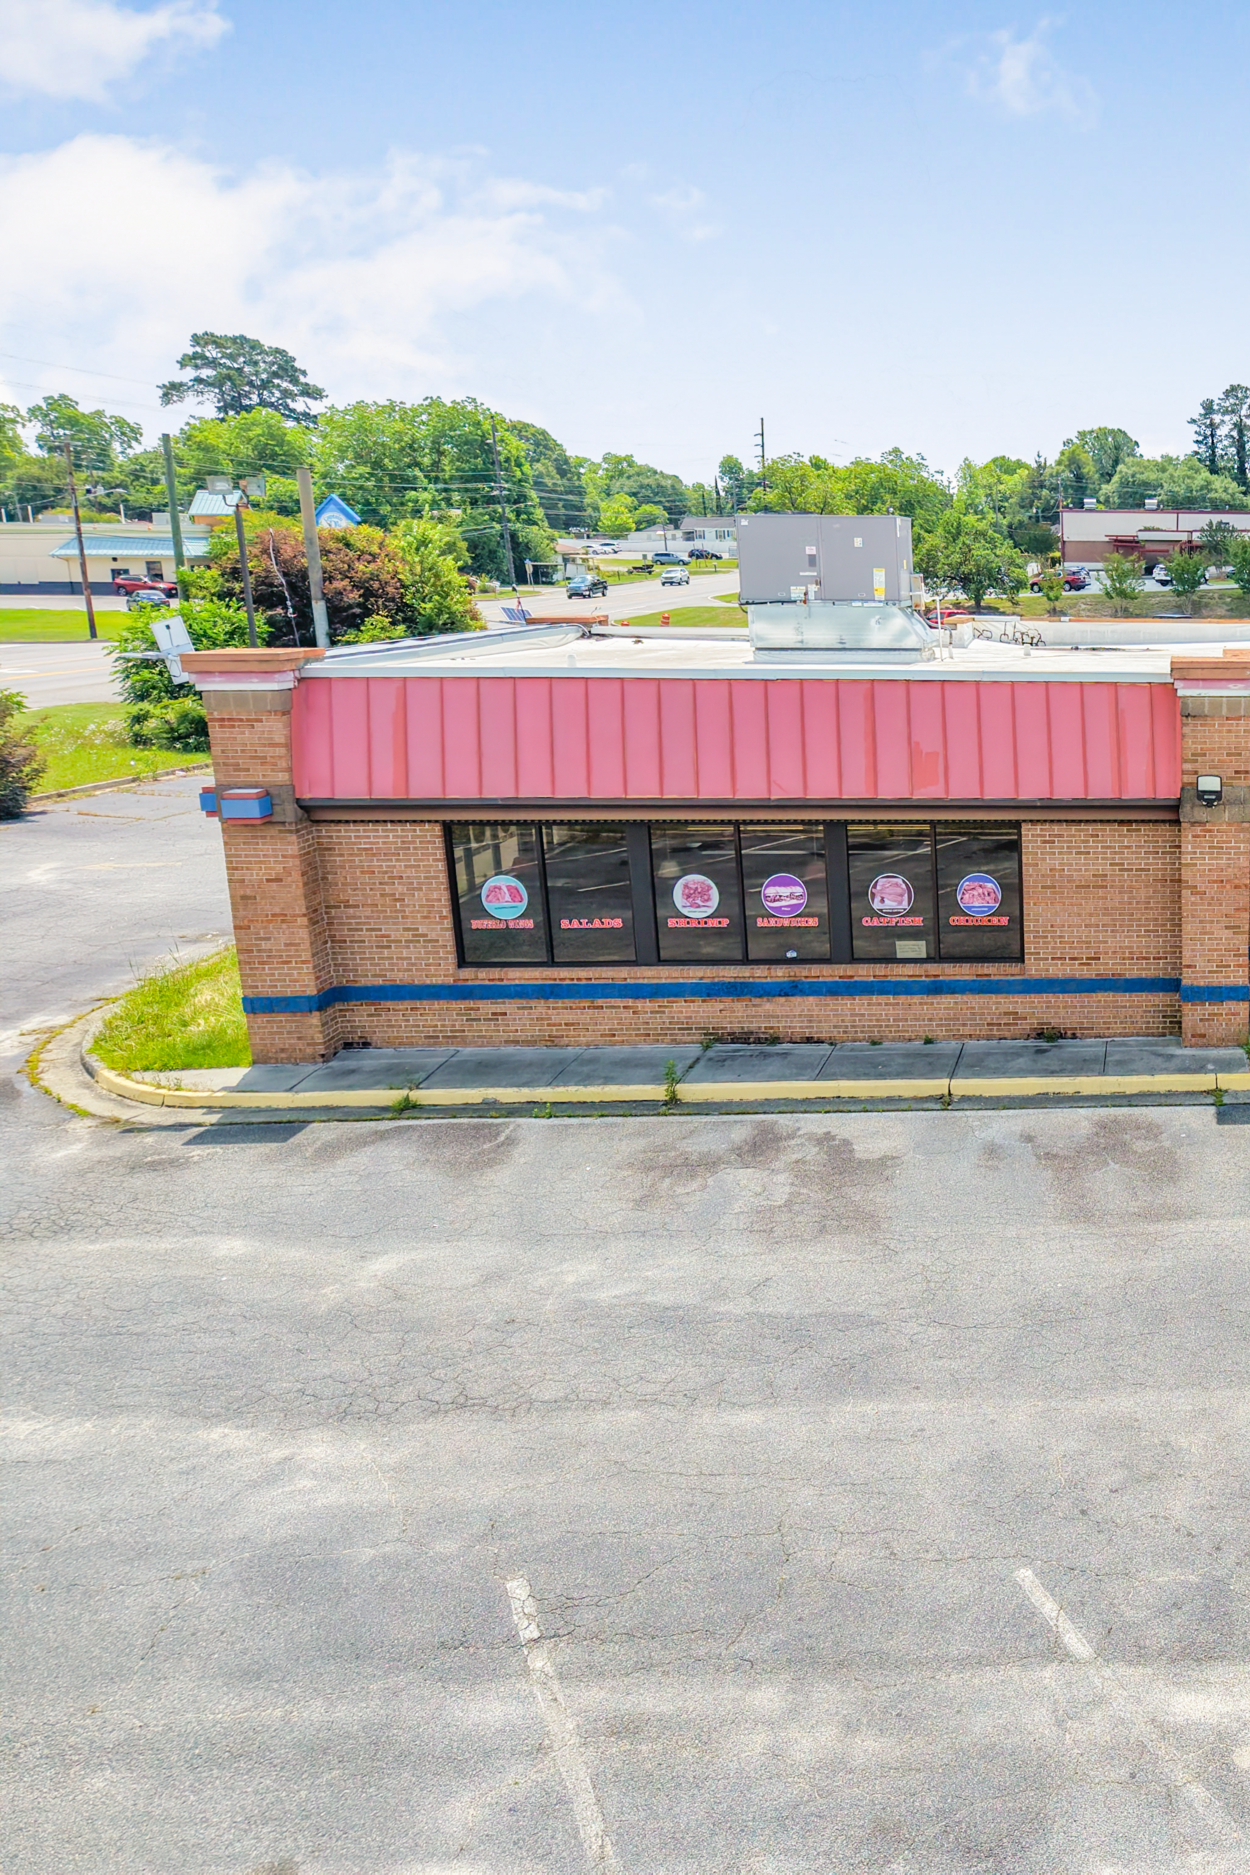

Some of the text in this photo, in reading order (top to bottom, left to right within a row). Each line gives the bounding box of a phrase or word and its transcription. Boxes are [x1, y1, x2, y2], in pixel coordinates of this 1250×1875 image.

[470, 918, 534, 930] BUFFALO WINGS
[560, 918, 623, 929] SALADS
[667, 917, 730, 928] SHRIMP
[756, 917, 819, 927] SANDWICHES
[862, 916, 924, 926] CATFISH
[949, 916, 1010, 926] CHICKEN
